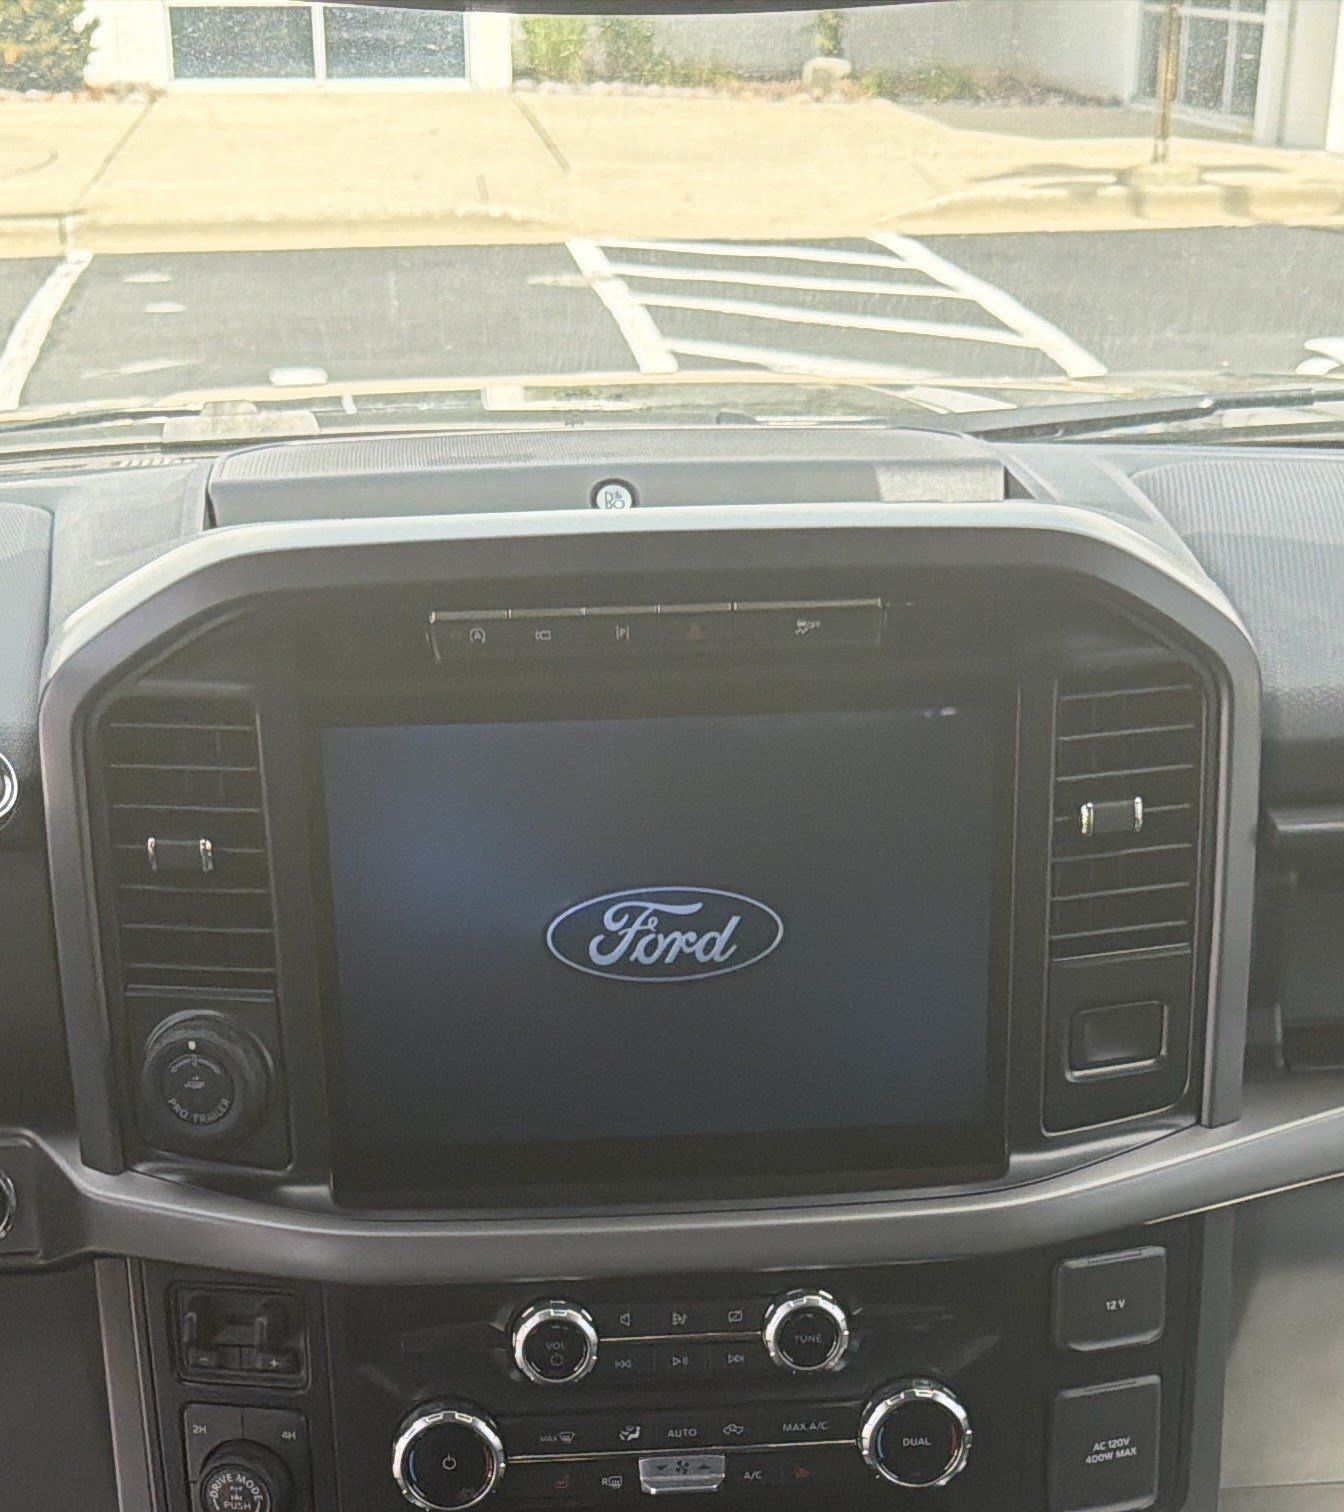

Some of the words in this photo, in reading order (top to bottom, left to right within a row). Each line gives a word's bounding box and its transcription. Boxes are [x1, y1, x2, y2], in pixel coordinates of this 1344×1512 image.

[588, 900, 742, 967] Ford
[794, 1334, 824, 1344] TUNE
[545, 1341, 565, 1350] VOL
[192, 1423, 207, 1435] 2H
[782, 1422, 807, 1432] MAX
[809, 1420, 829, 1431] A/C
[281, 1430, 296, 1441] 4H
[666, 1428, 698, 1439] AUTO
[902, 1436, 931, 1447] DUAL
[1092, 1441, 1107, 1452] AC
[1108, 1436, 1131, 1449] 120V
[1086, 1451, 1114, 1464] 400W
[1116, 1447, 1137, 1459] MAX
[743, 1470, 763, 1481] A/C
[209, 1473, 233, 1499] DRIVE
[236, 1473, 264, 1502] MODE
[223, 1500, 252, 1511] PUSH
